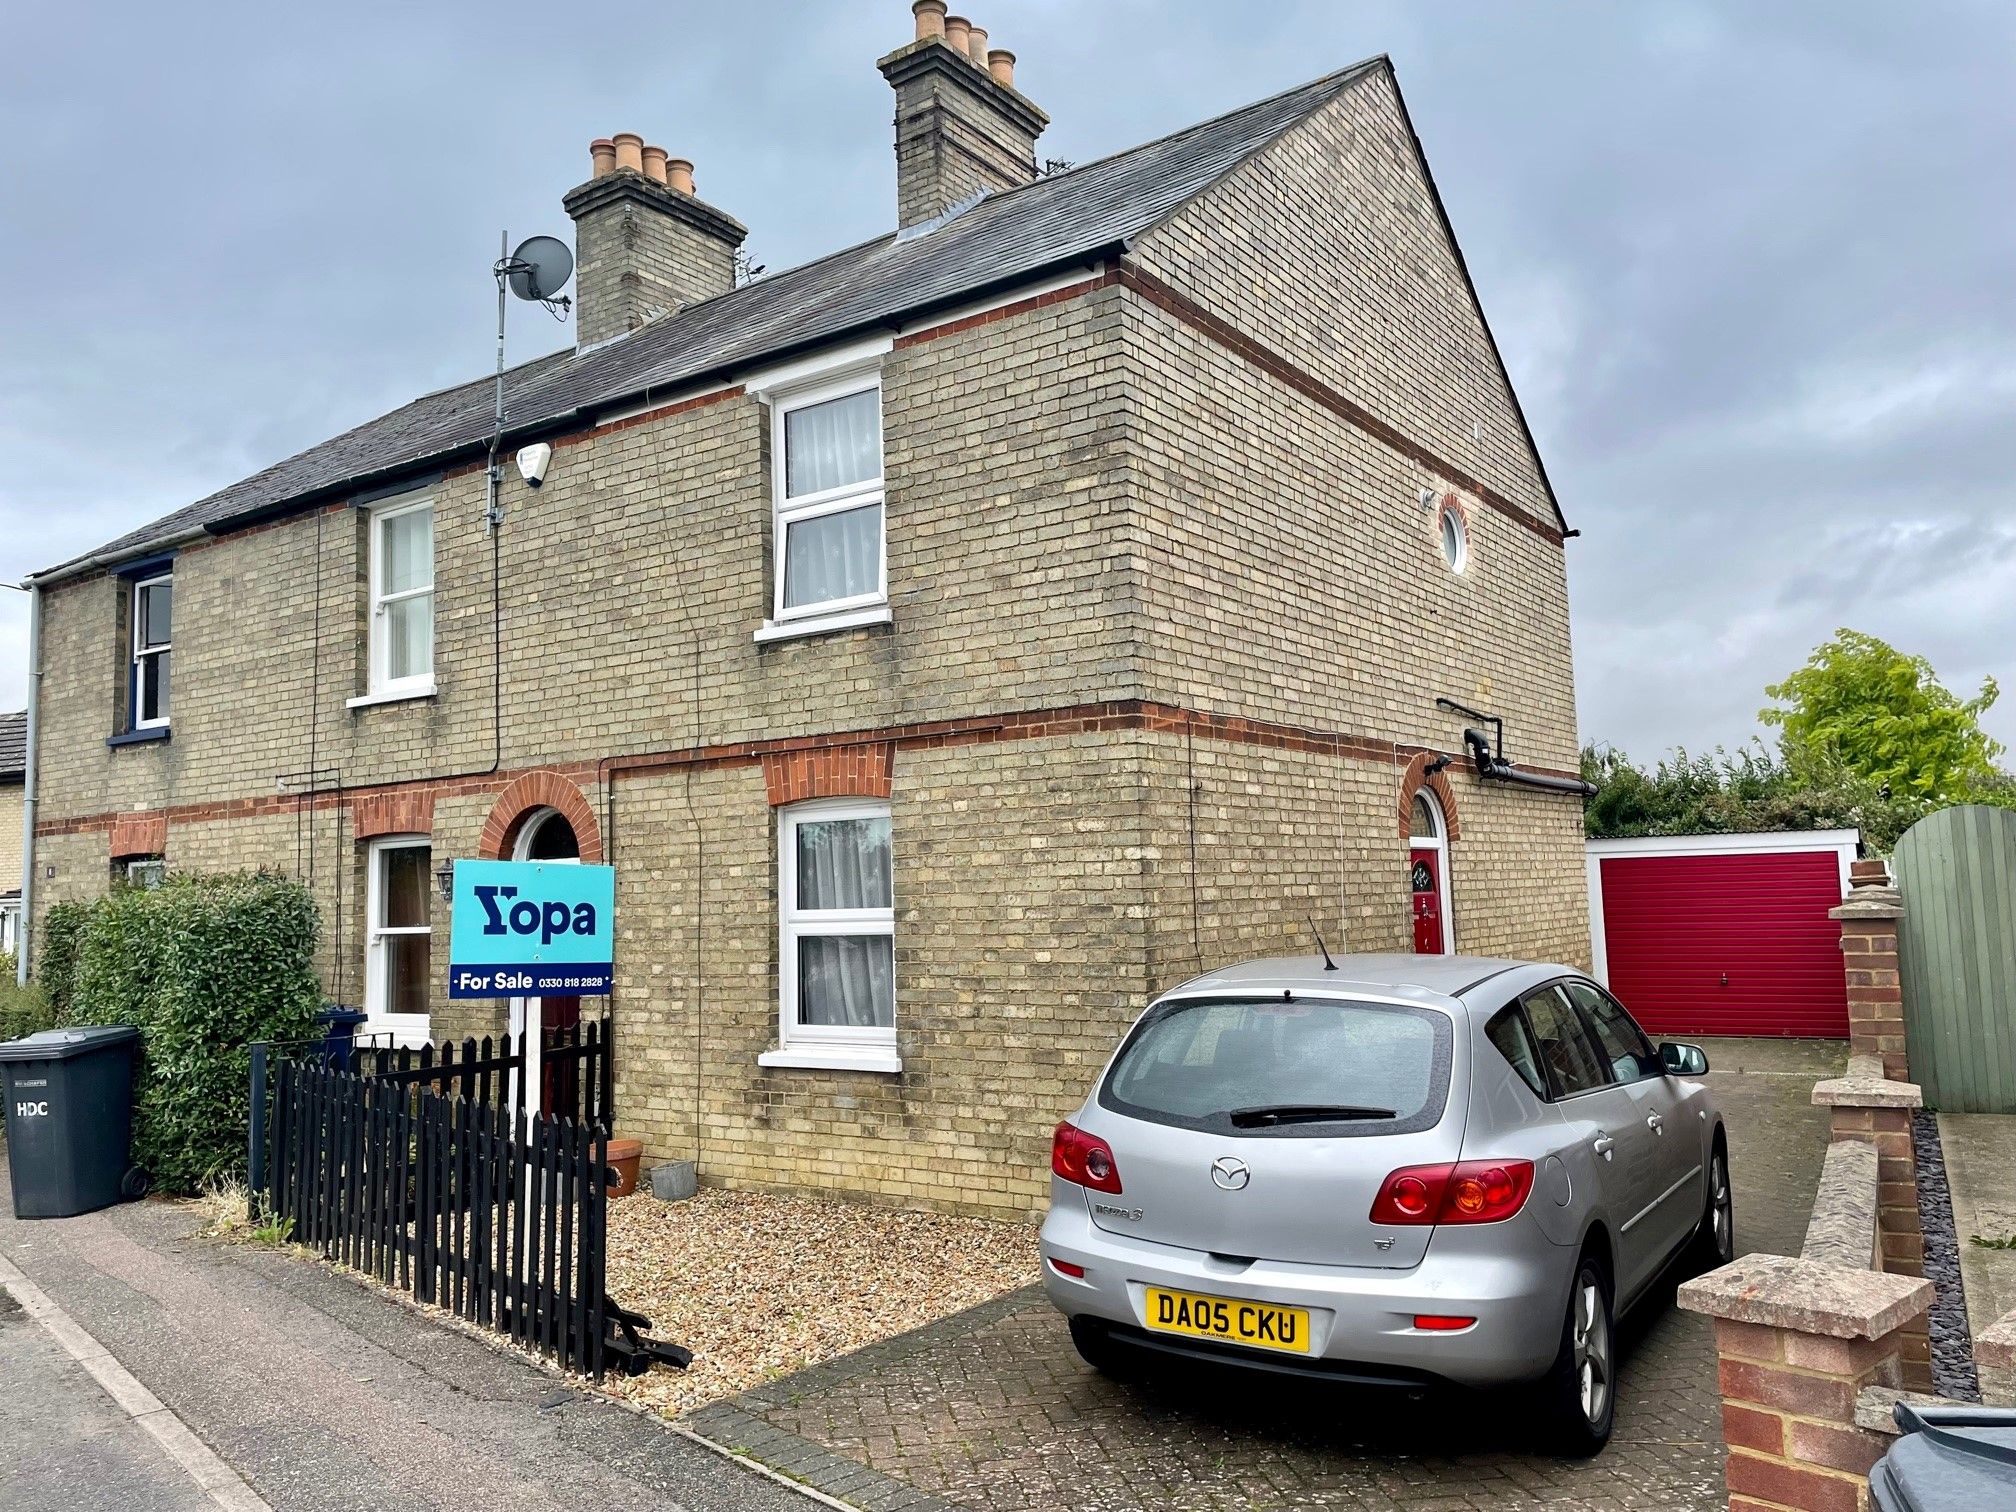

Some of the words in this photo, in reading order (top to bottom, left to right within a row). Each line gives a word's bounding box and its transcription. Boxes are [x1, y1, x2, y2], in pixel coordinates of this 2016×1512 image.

[474, 886, 596, 945] Yopa
[460, 973, 490, 990] For
[494, 972, 533, 989] Sale
[539, 977, 563, 988] 0330
[564, 977, 580, 987] 818
[581, 977, 603, 987] 2828
[17, 1101, 48, 1117] HDC
[1158, 1294, 1230, 1333] DA05
[1238, 1307, 1296, 1344] CKU
